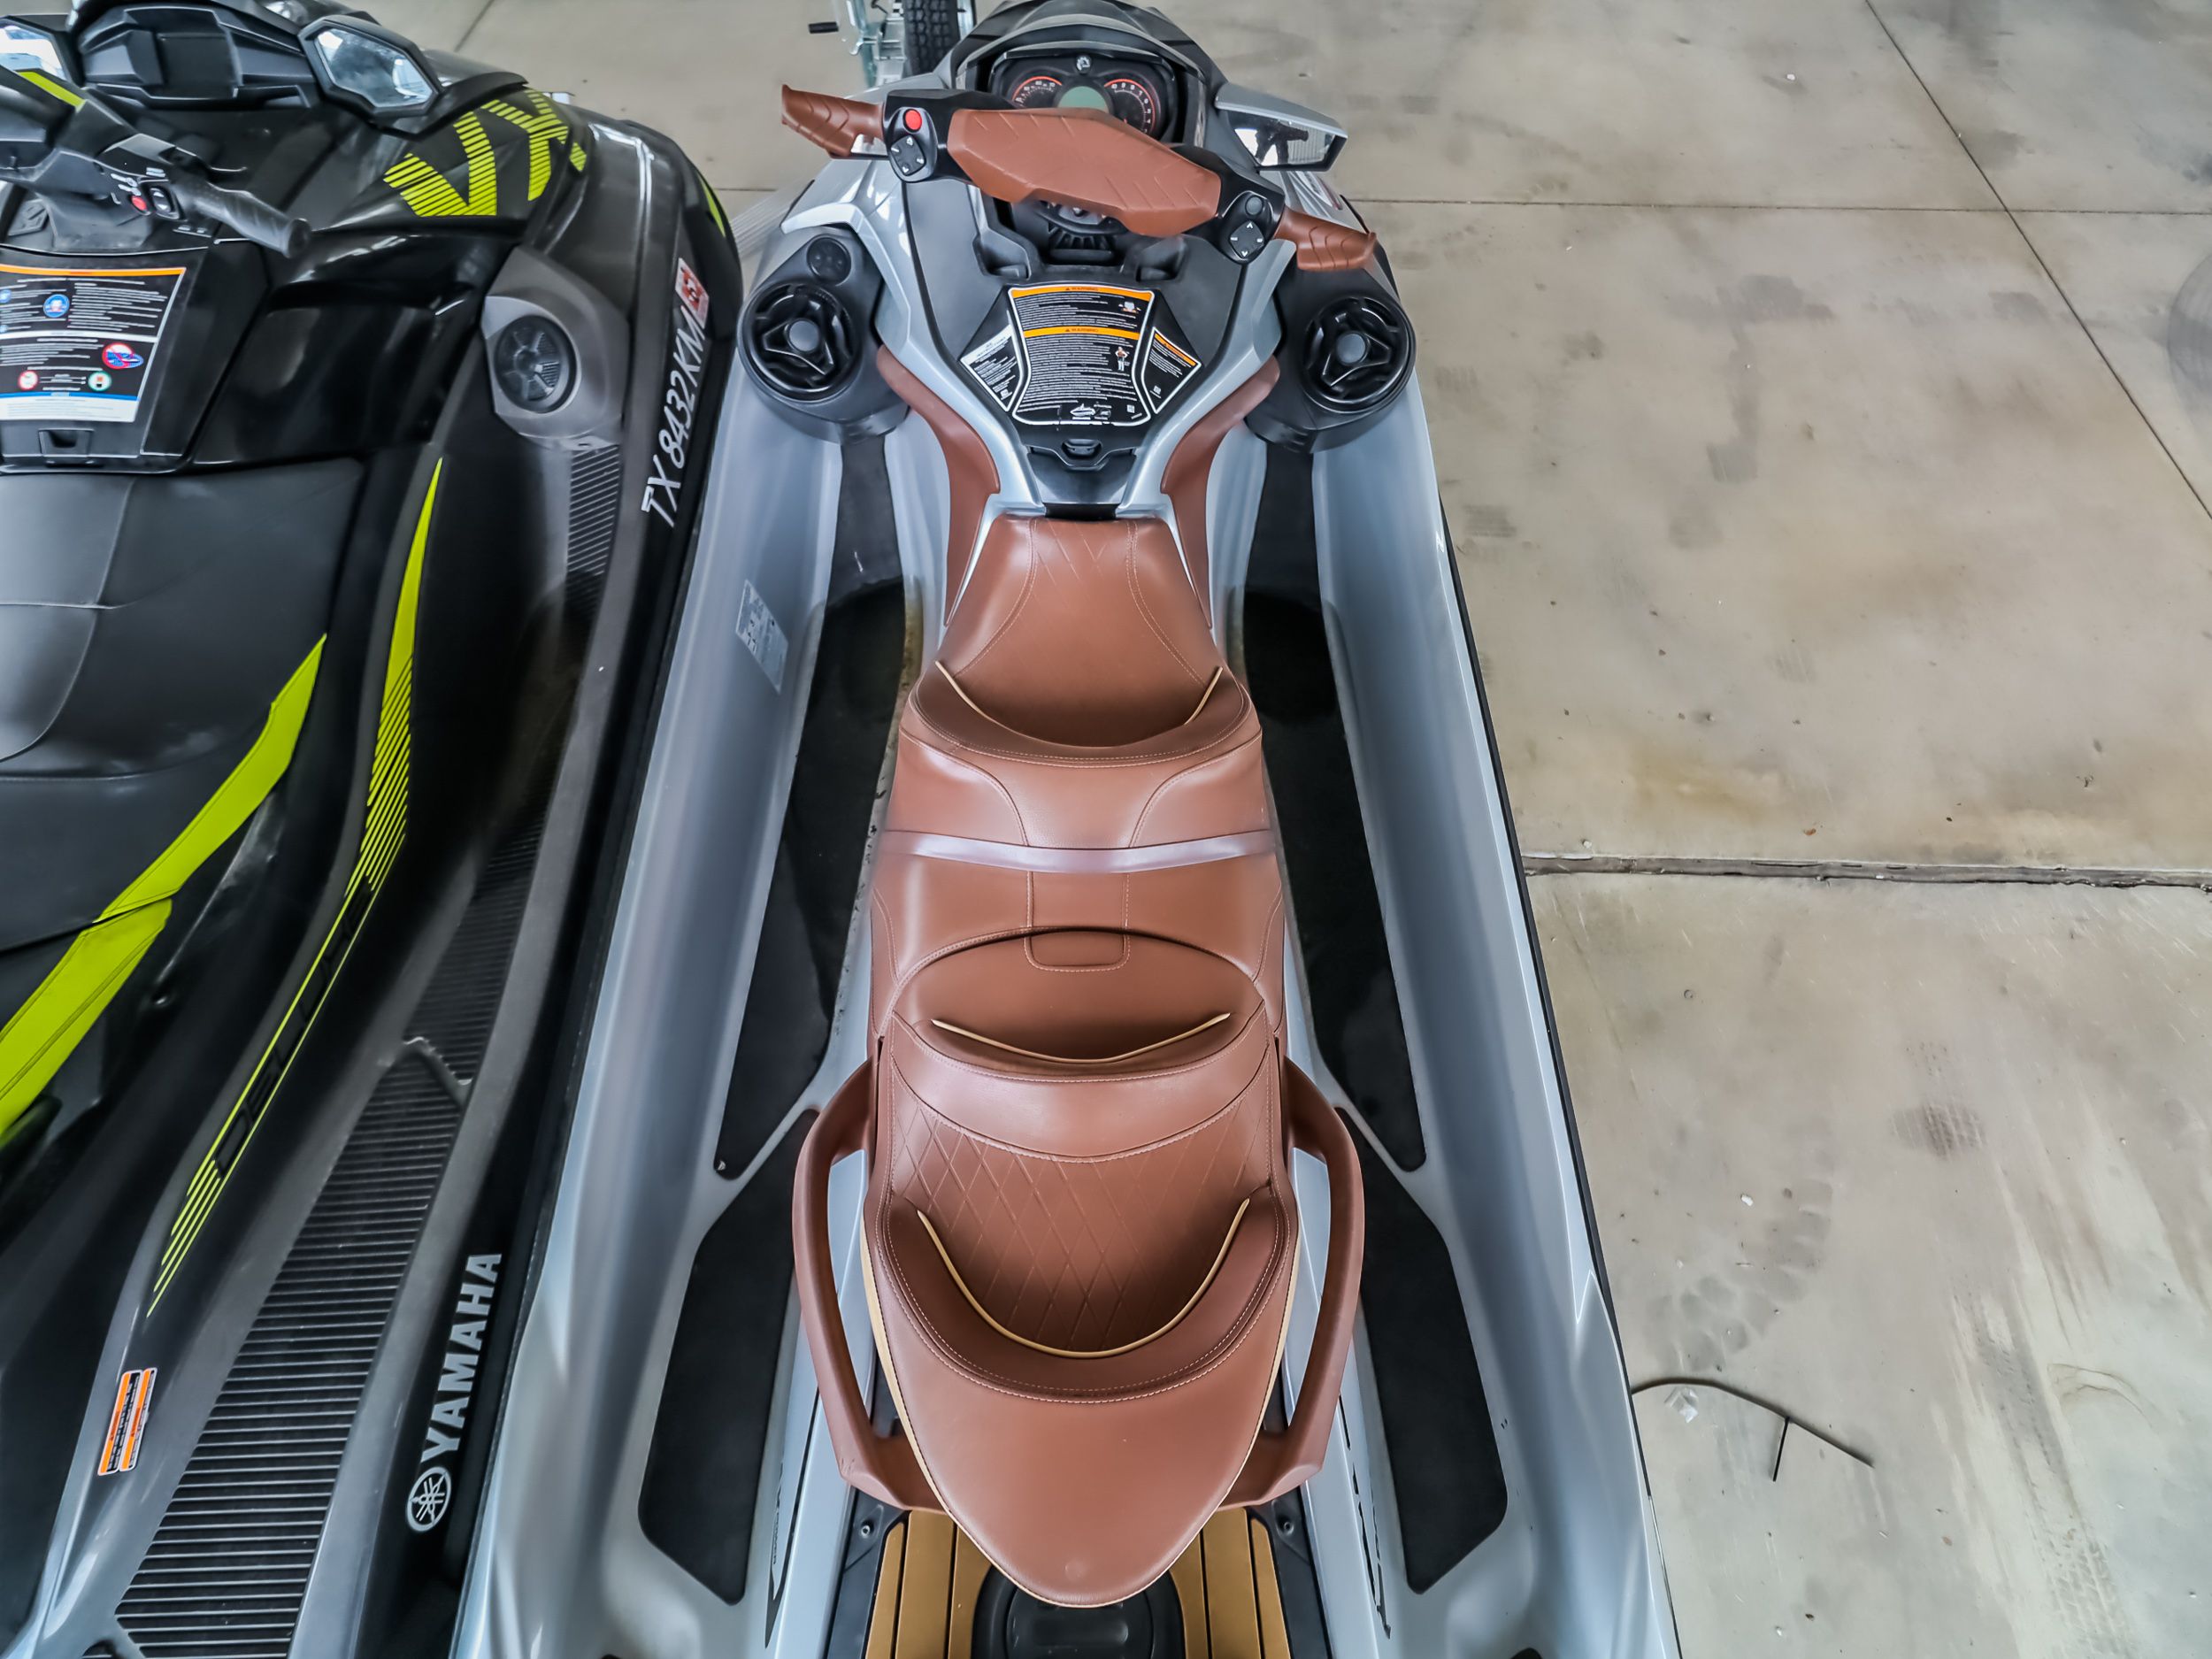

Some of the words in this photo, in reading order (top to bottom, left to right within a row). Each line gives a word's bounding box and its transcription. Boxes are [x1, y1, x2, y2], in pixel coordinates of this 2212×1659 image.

[383, 88, 587, 217] VX
[641, 454, 681, 528] TX
[420, 1253, 503, 1463] YAMAHA
